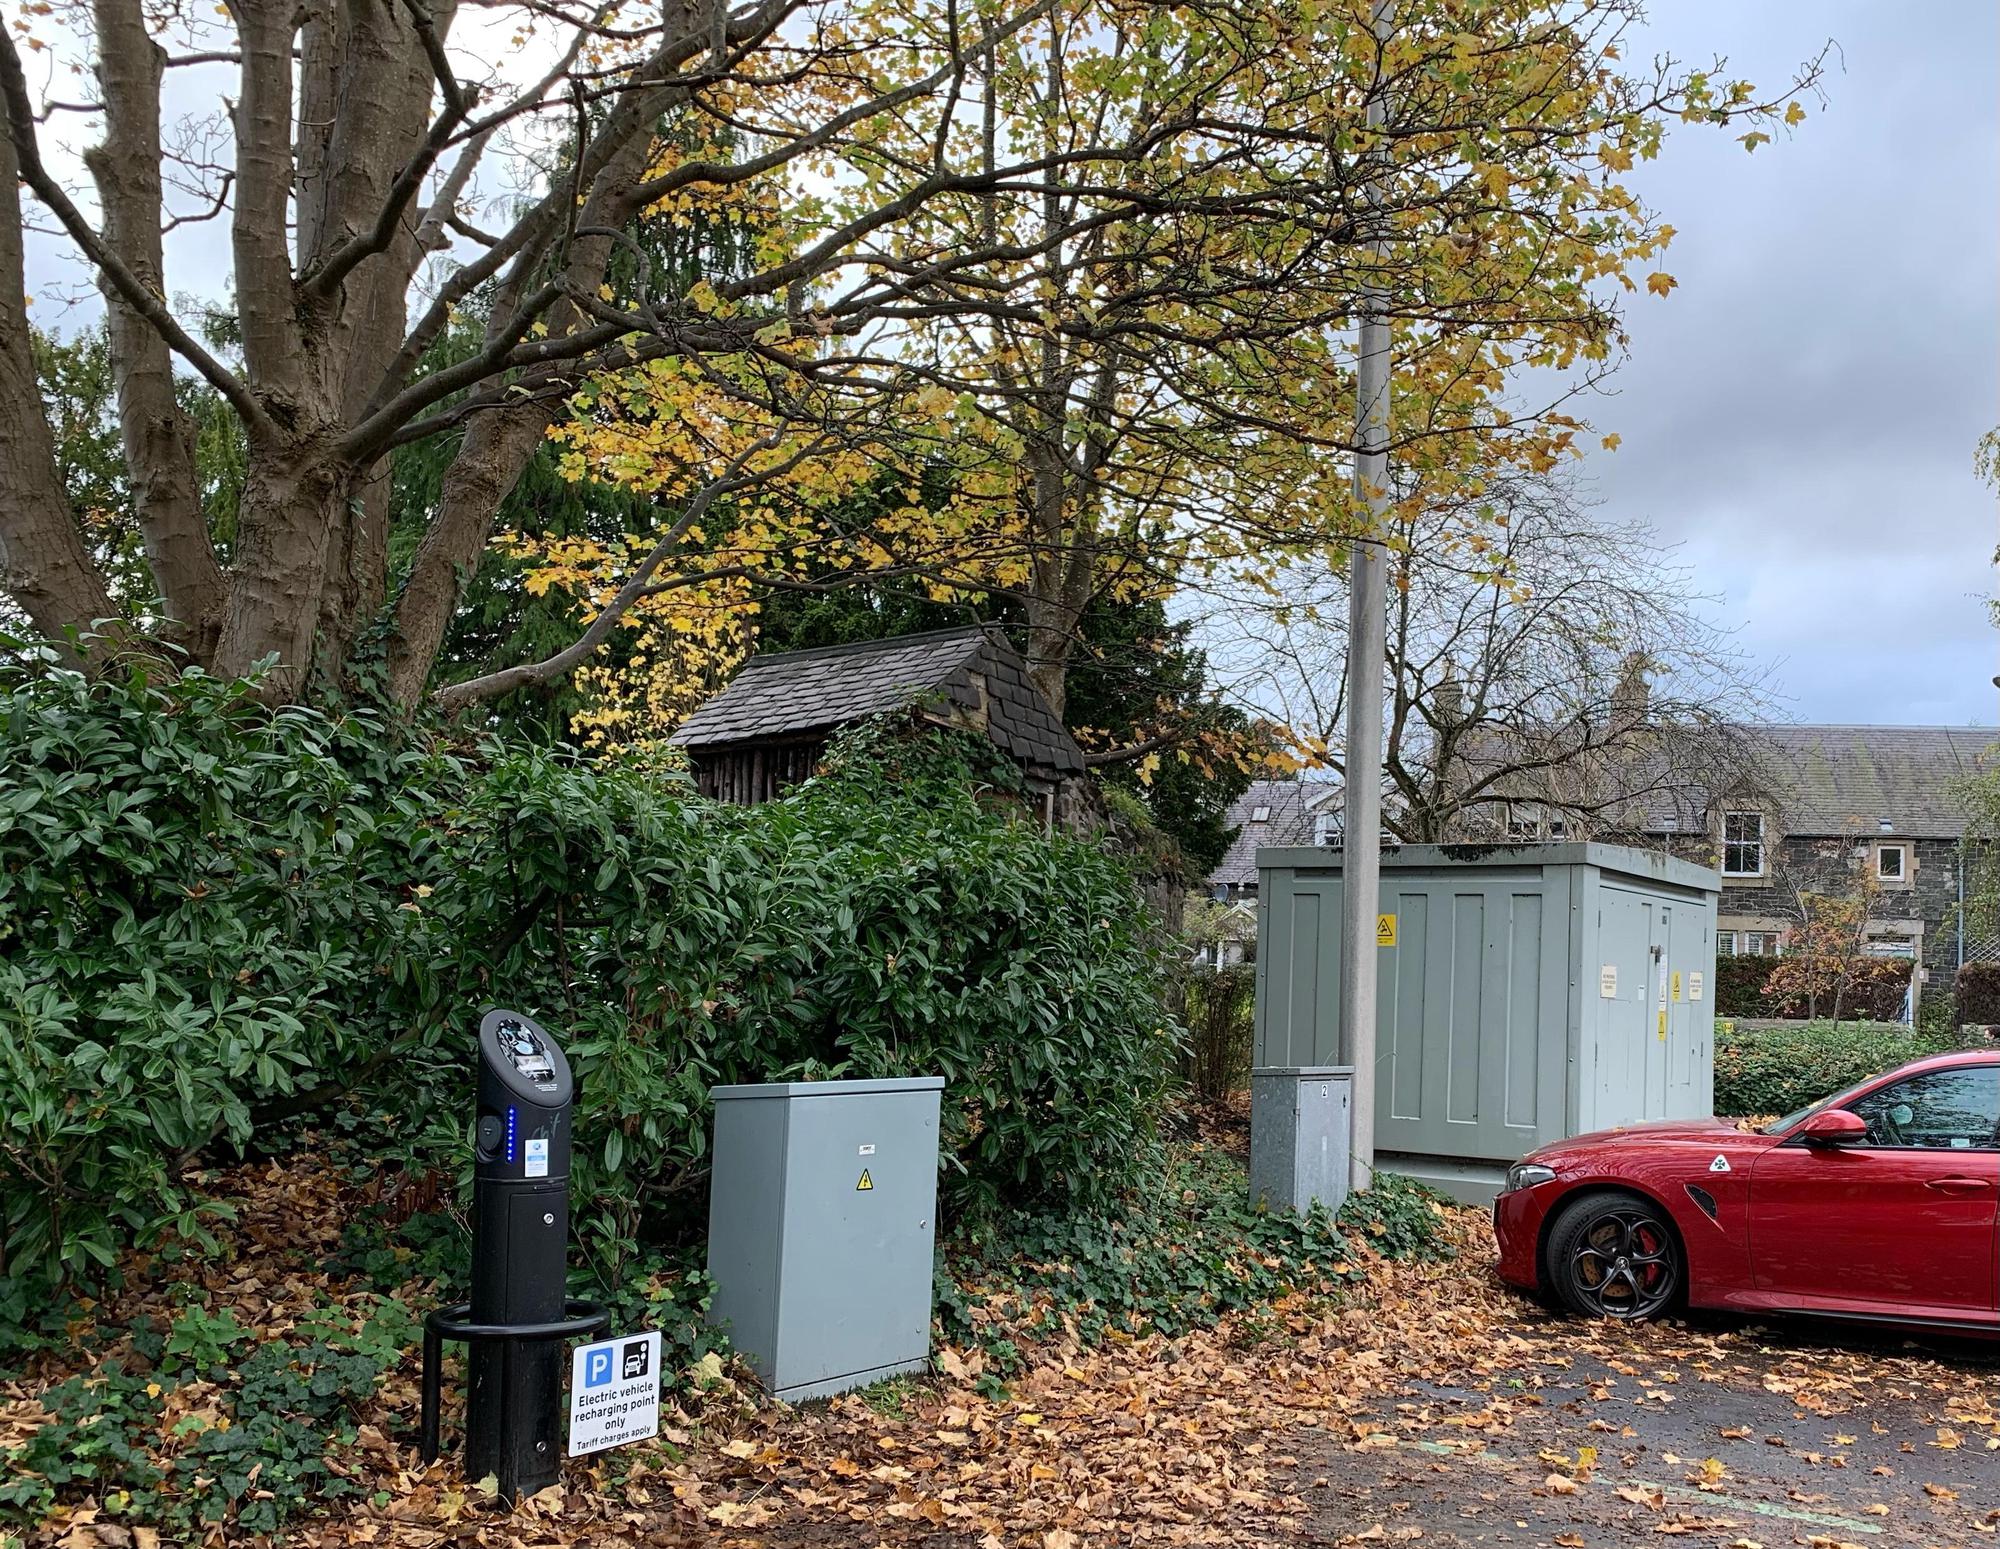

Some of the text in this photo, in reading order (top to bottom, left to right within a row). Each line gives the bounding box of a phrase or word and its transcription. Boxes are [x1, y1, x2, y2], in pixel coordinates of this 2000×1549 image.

[1322, 1085, 1327, 1097] 2
[592, 1354, 608, 1382] P
[578, 1382, 654, 1407] Electric vehicle
[575, 1395, 655, 1422] recharging point
[605, 1417, 626, 1430] only
[577, 1425, 652, 1450] Tariff charges apply
